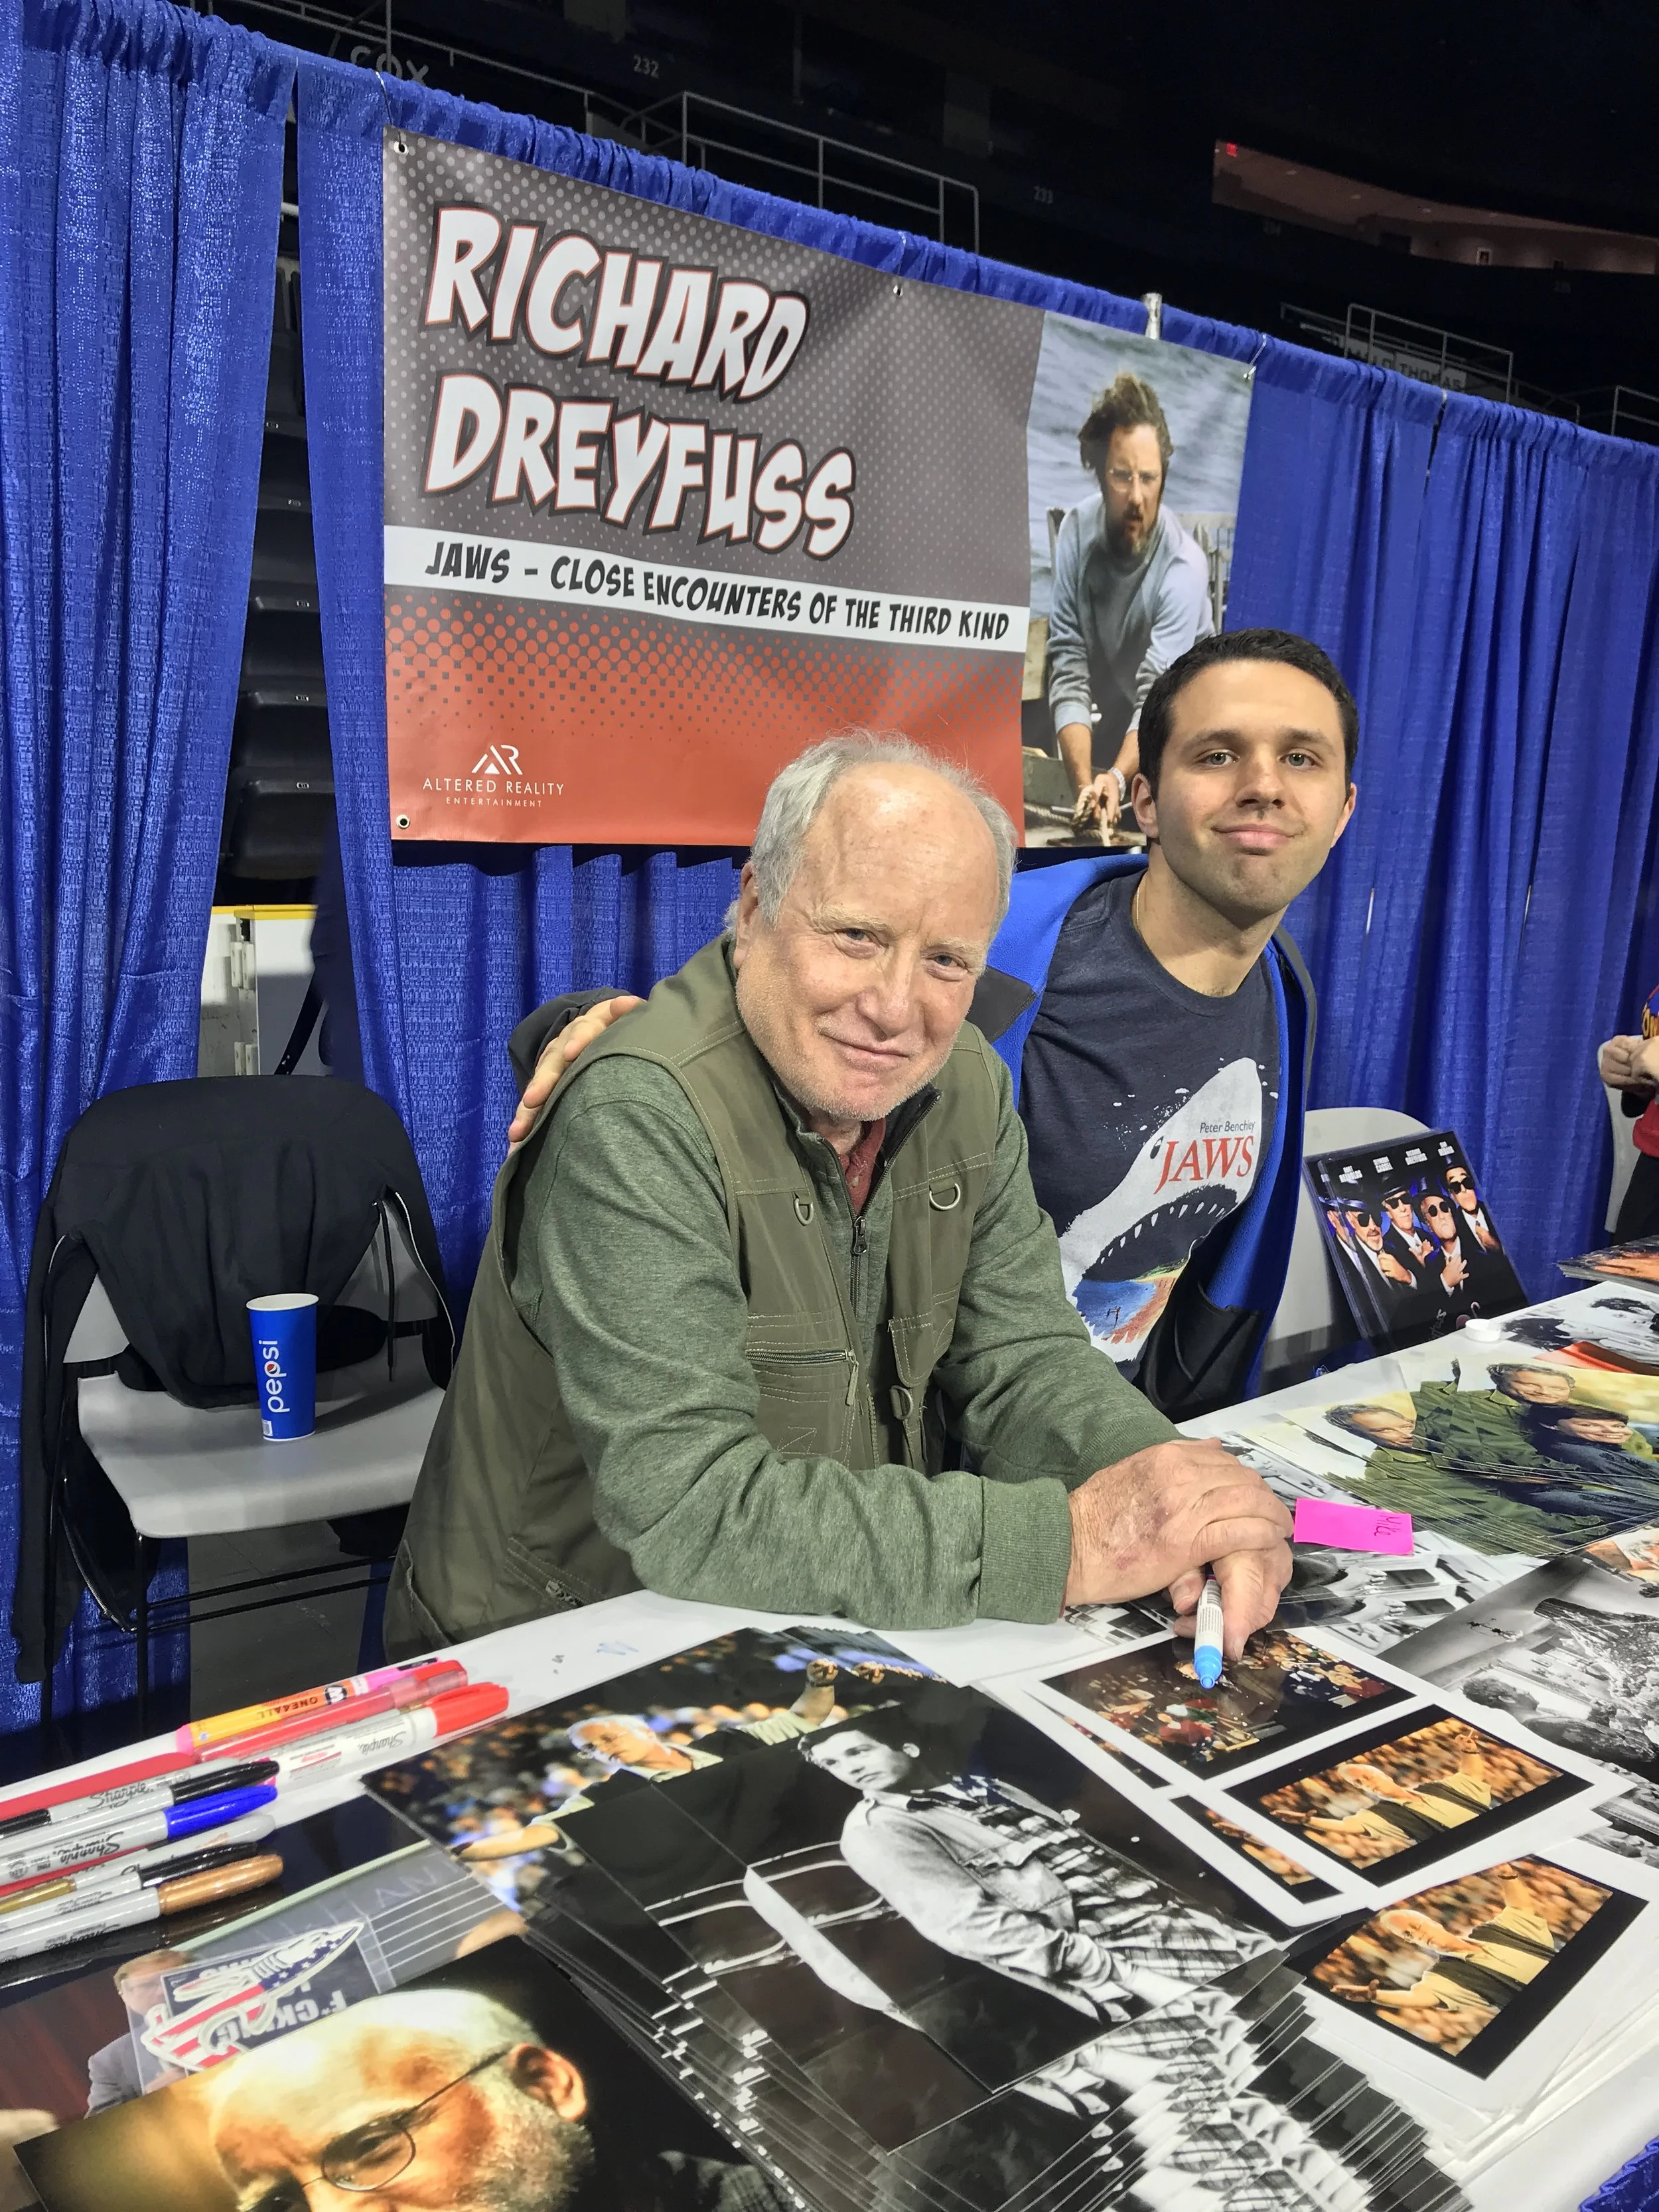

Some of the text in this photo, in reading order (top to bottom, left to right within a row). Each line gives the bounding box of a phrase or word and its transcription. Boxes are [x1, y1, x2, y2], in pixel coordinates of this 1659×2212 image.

[632, 55, 660, 79] 232
[423, 204, 809, 402] RICHARD
[423, 372, 855, 557] DREYFUSS
[425, 542, 510, 583] JAWS
[550, 555, 635, 597] CLOSE
[643, 571, 801, 622] ENCOUNTERS
[809, 592, 837, 625] OF
[845, 598, 880, 629] THE
[889, 603, 952, 636] THIRD
[958, 609, 1009, 640] KIND
[422, 777, 565, 796] ALTERED REALITY
[445, 796, 542, 808] ENTERTAINMENT
[1200, 1119, 1256, 1134] Peter Benchley
[1153, 1136, 1254, 1194] JAWS
[258, 1340, 290, 1413] pepsi
[257, 1696, 319, 1720] ONE4ALL
[359, 1731, 408, 1755] Sharpie
